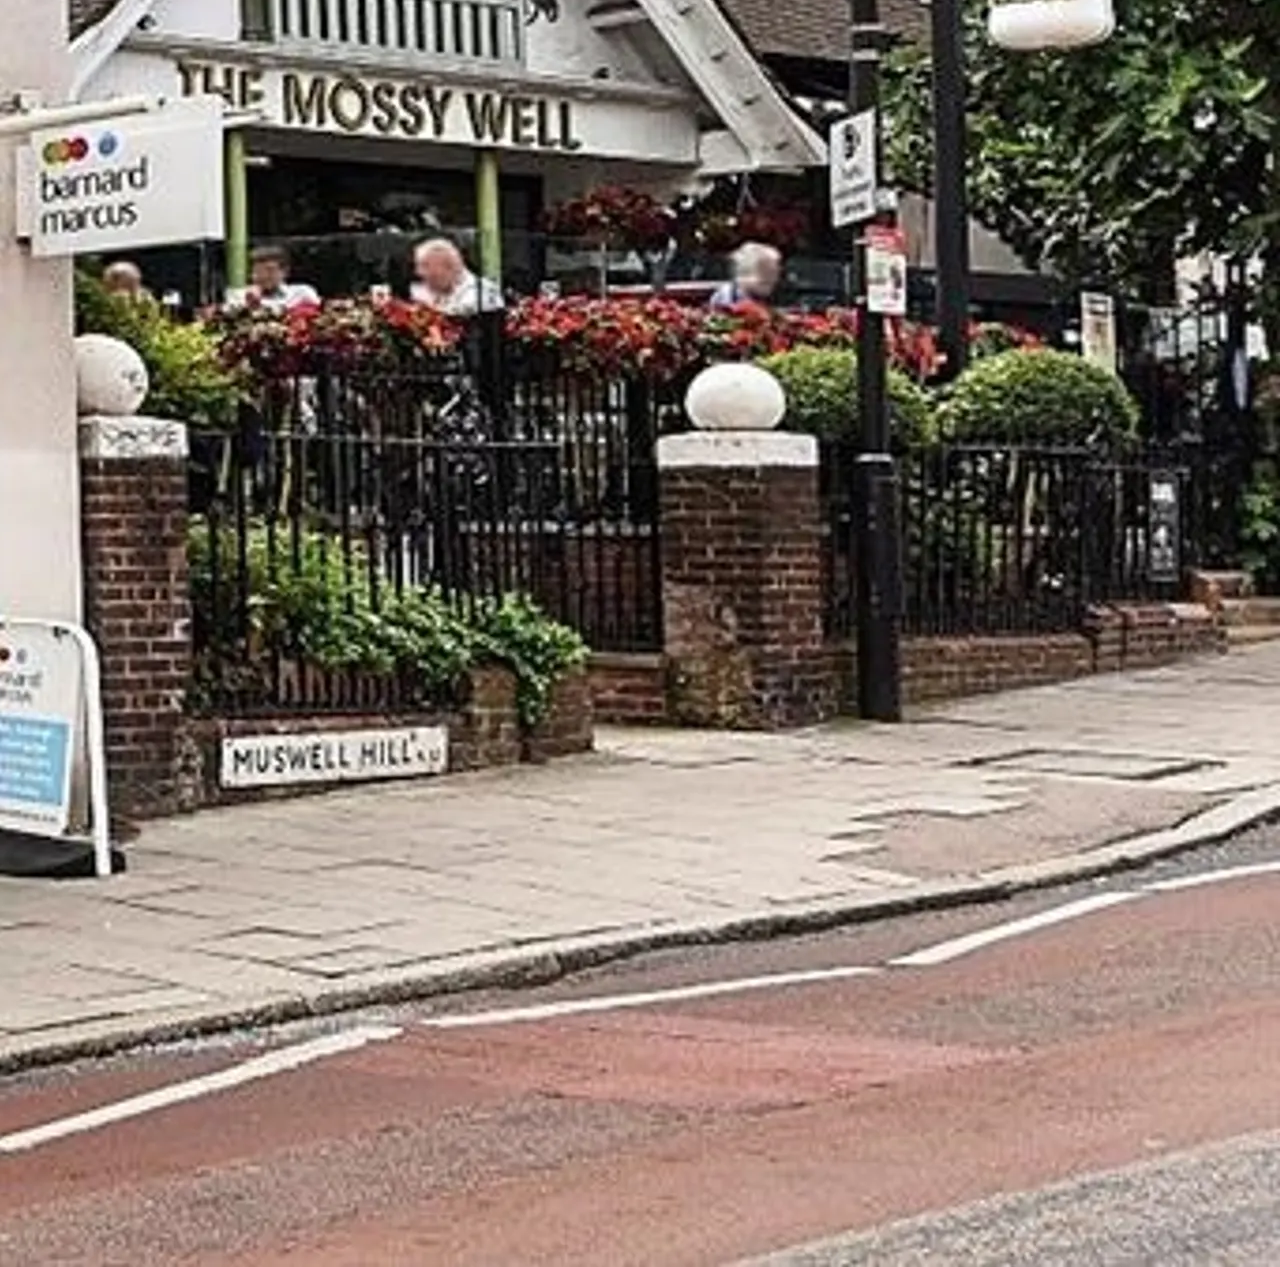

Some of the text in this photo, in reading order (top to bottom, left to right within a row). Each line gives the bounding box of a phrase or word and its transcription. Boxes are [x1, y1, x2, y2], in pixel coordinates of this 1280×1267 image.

[176, 61, 582, 151] THE MOSSY WELL
[40, 156, 149, 204] barnard
[40, 199, 139, 235] marcus
[232, 742, 350, 775] MUSWELL
[360, 738, 412, 766] HILL
